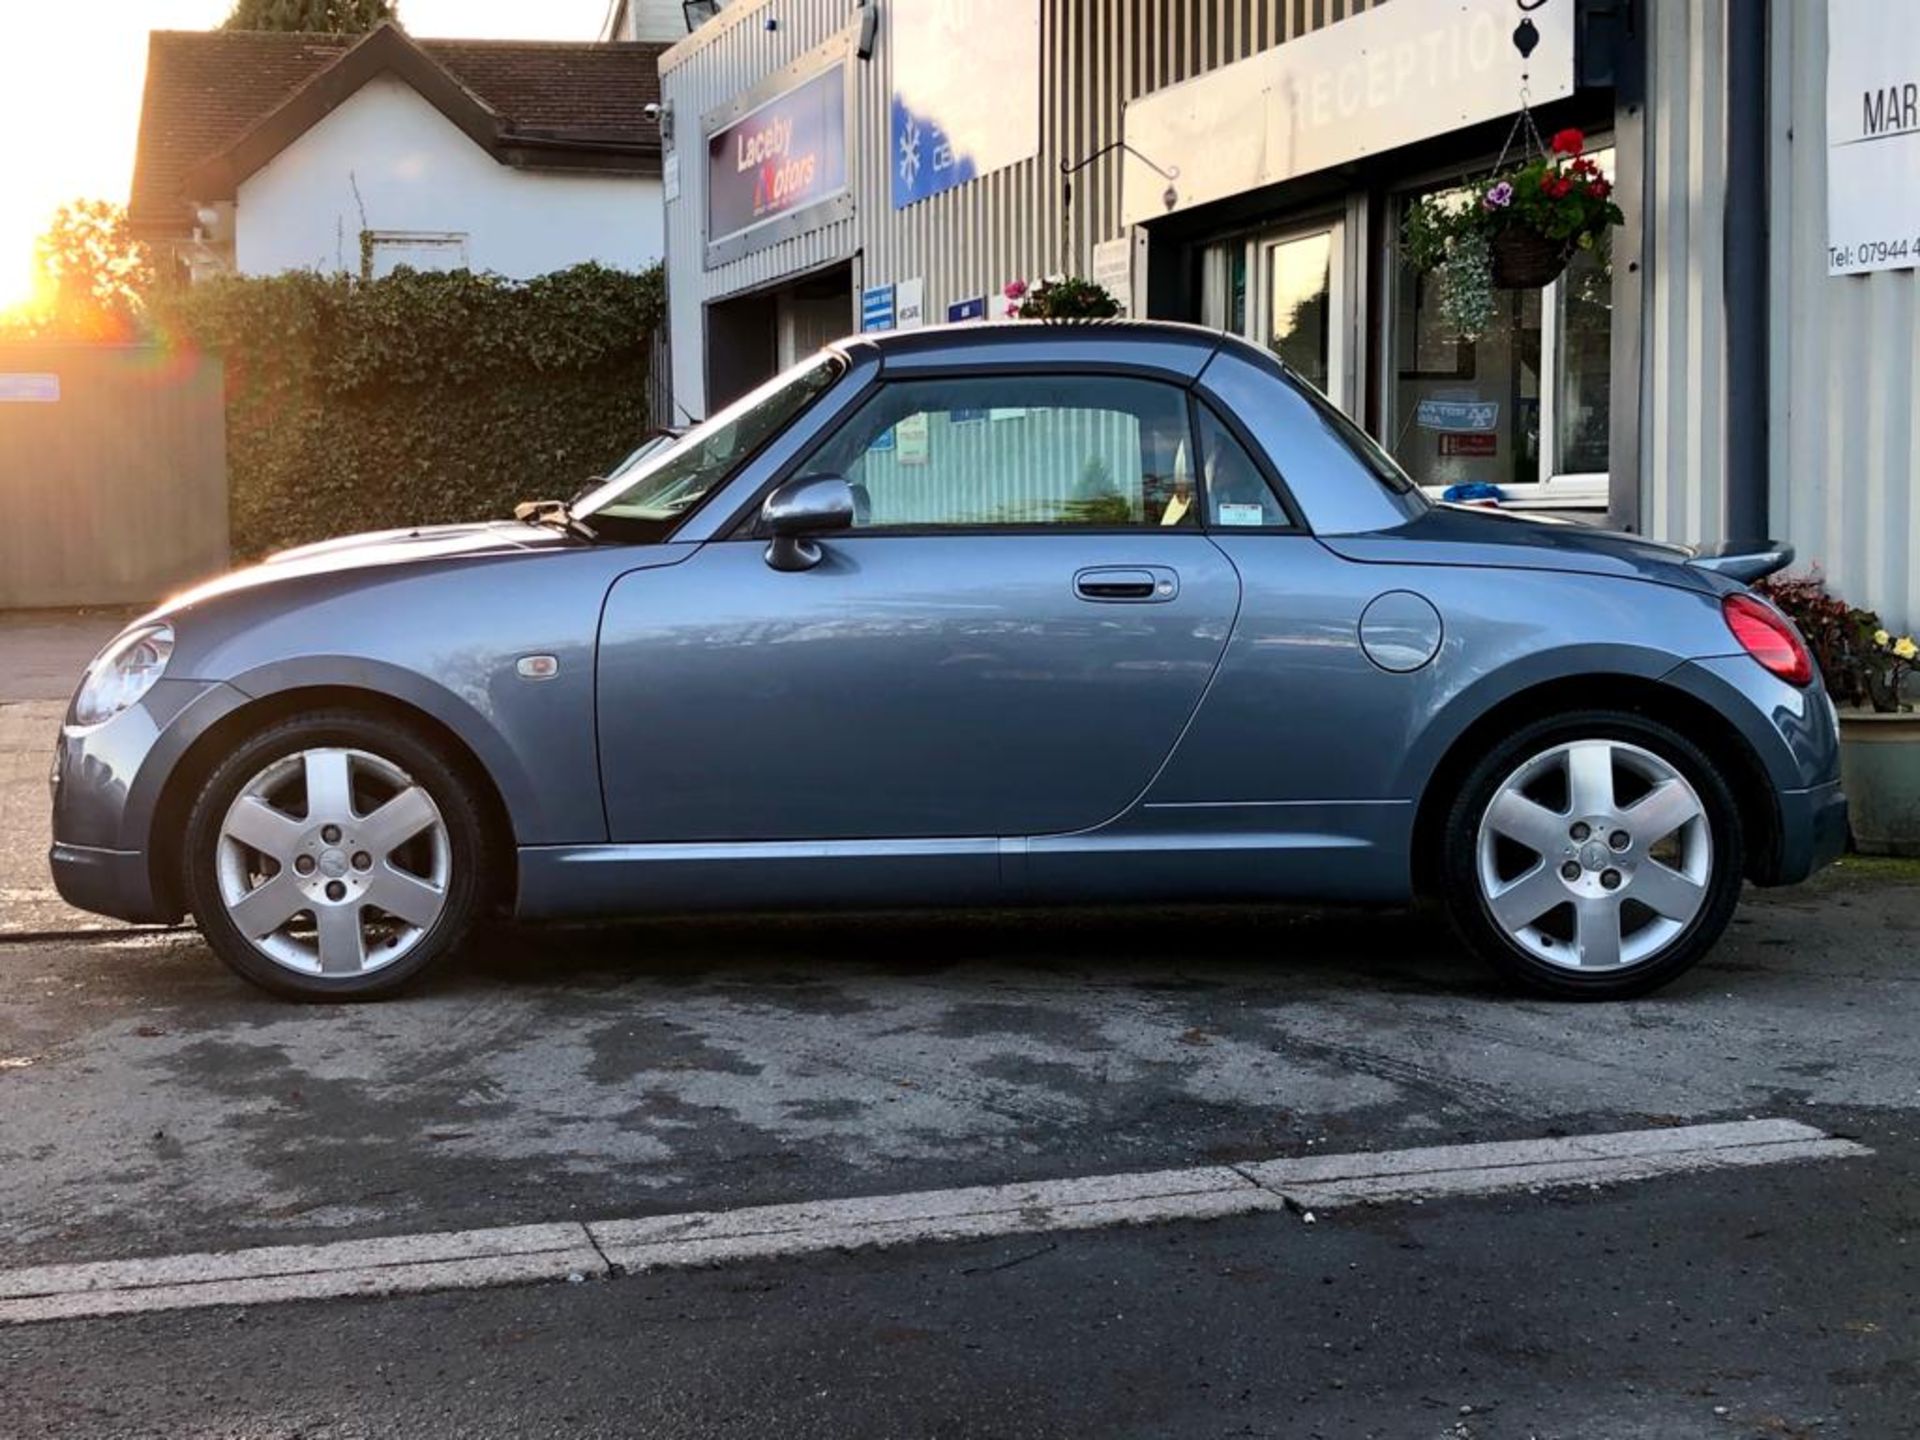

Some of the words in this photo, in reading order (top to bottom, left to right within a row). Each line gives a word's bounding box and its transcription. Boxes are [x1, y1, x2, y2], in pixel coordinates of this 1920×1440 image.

[1292, 5, 1516, 131] ECEPTIO
[737, 116, 792, 173] Laceby
[1828, 246, 1854, 268] Tel:
[1858, 240, 1908, 264] 07944
